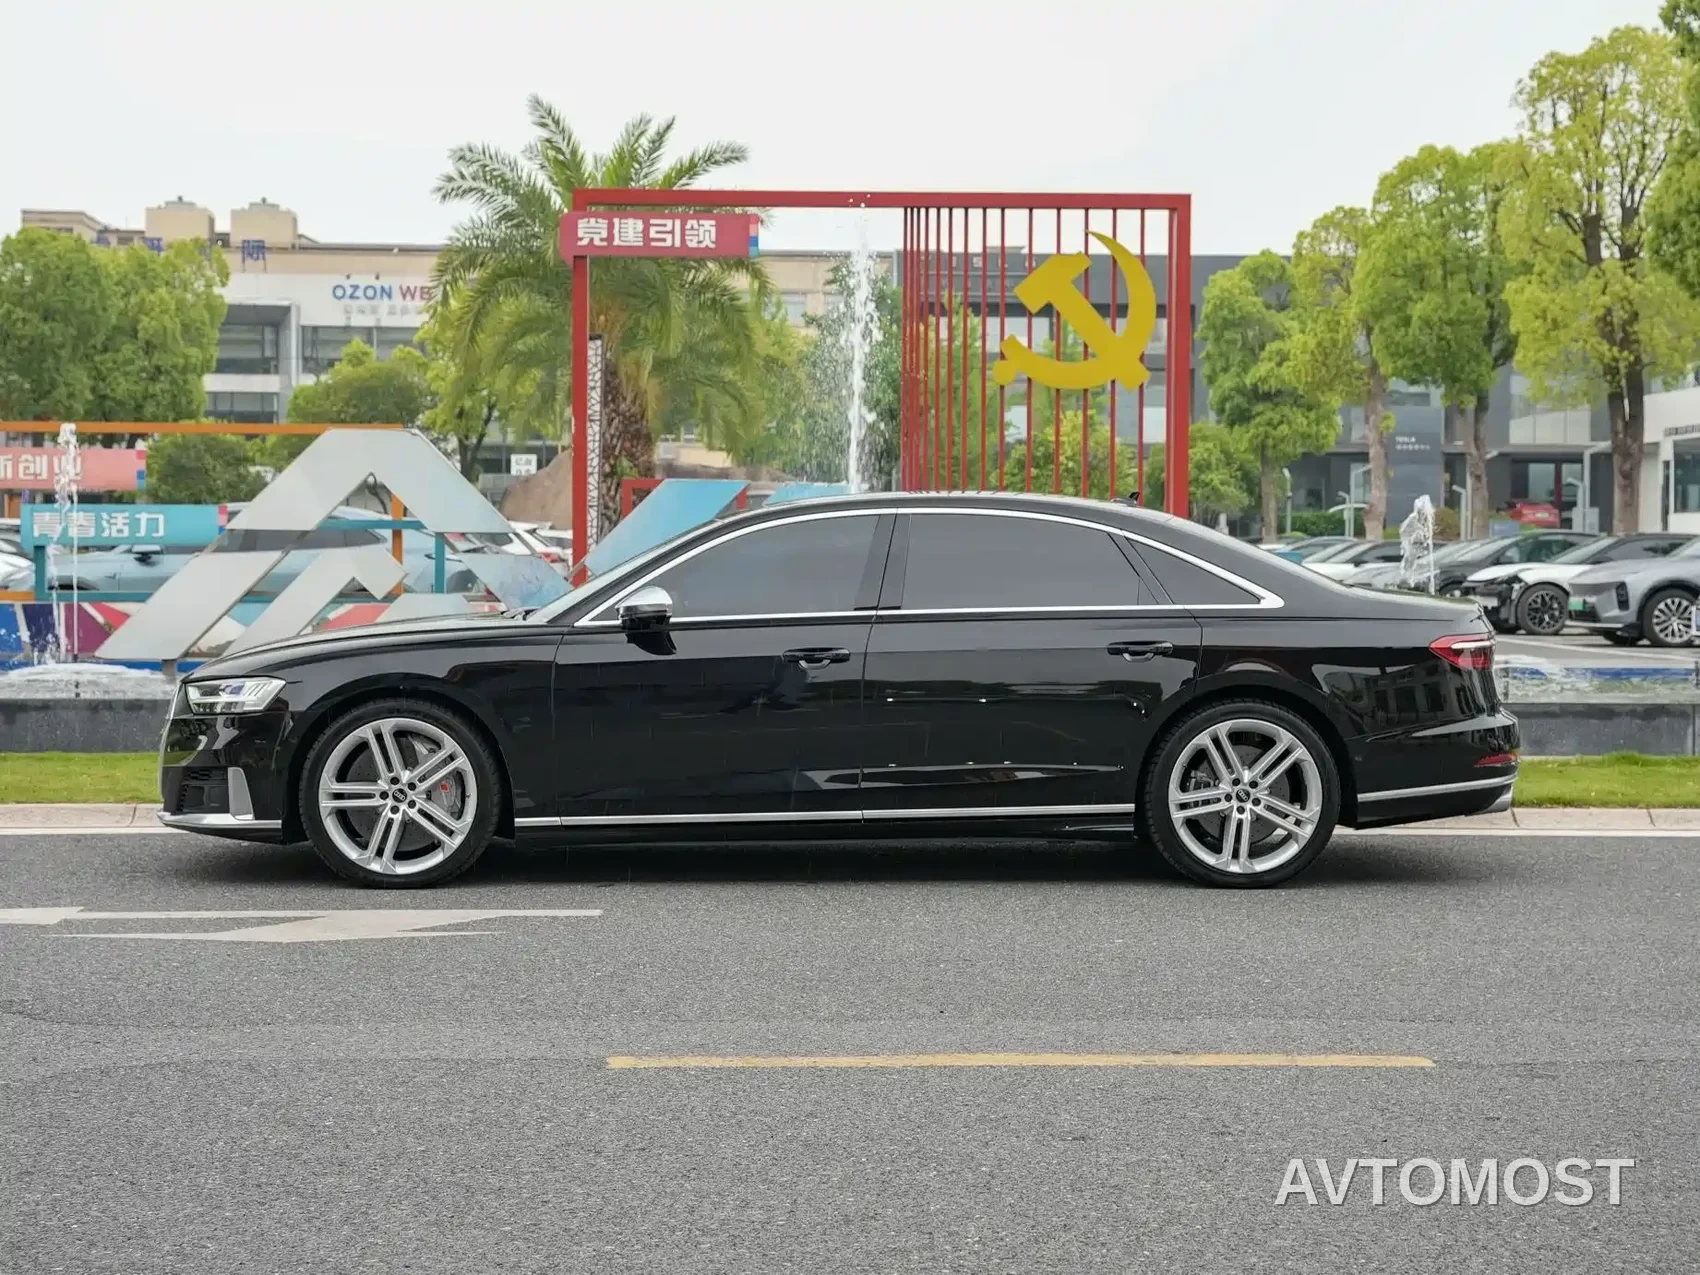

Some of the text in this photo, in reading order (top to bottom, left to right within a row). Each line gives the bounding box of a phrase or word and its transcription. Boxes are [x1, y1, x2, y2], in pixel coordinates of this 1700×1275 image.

[577, 217, 717, 249] 党建引领
[332, 284, 392, 301] OZON
[33, 511, 165, 538] 青春活力
